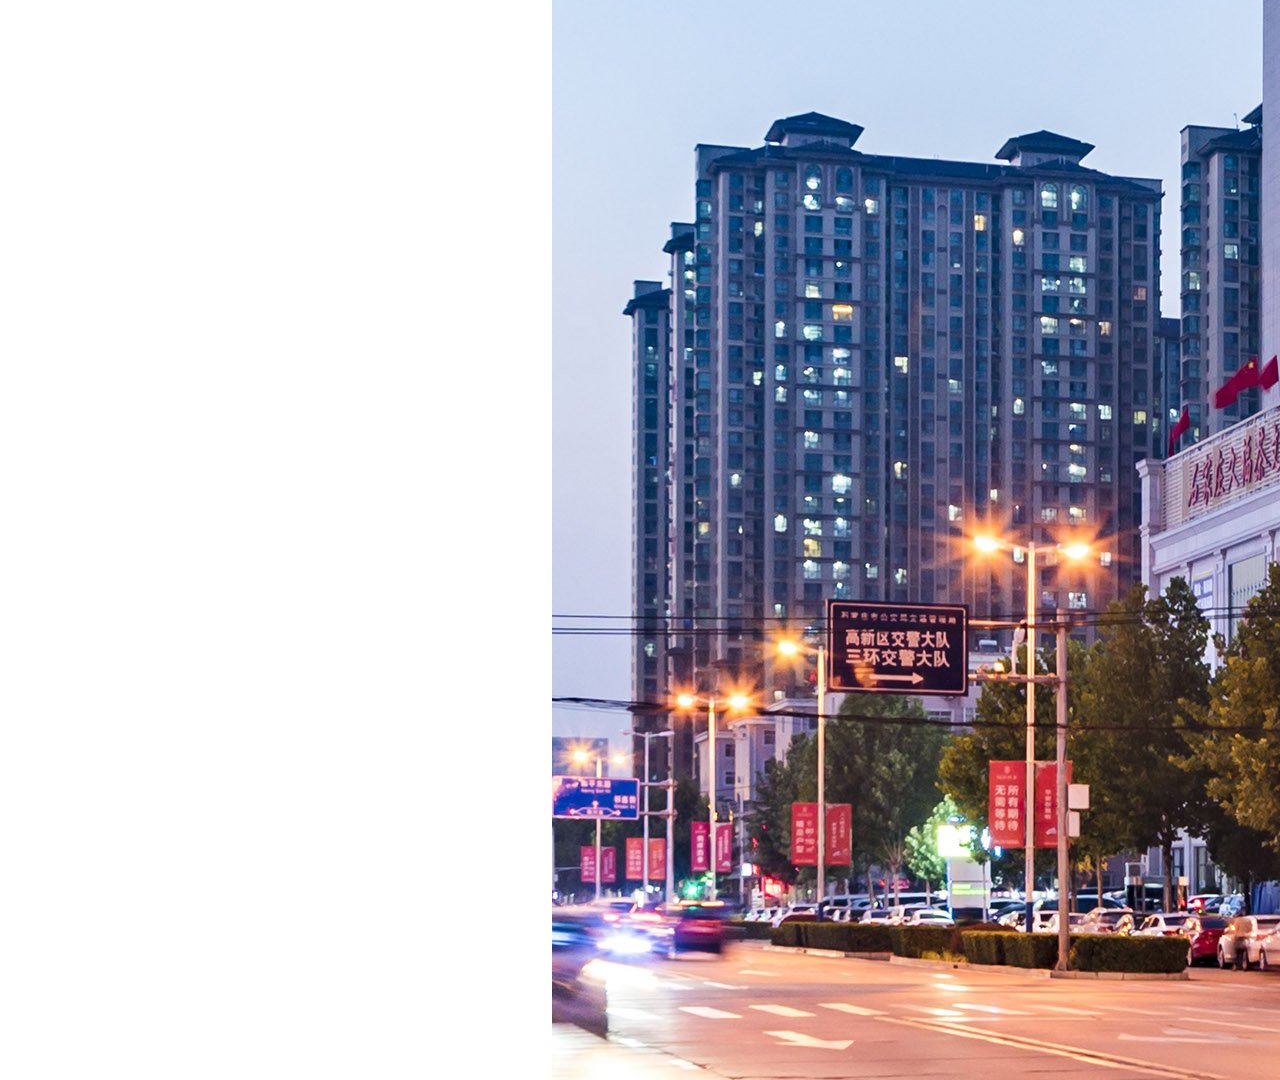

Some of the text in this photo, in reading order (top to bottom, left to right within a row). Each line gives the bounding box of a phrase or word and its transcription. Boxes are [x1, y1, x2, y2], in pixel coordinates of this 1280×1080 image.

[845, 628, 951, 649] 高新区交警大队
[845, 647, 951, 668] 三环交警大队
